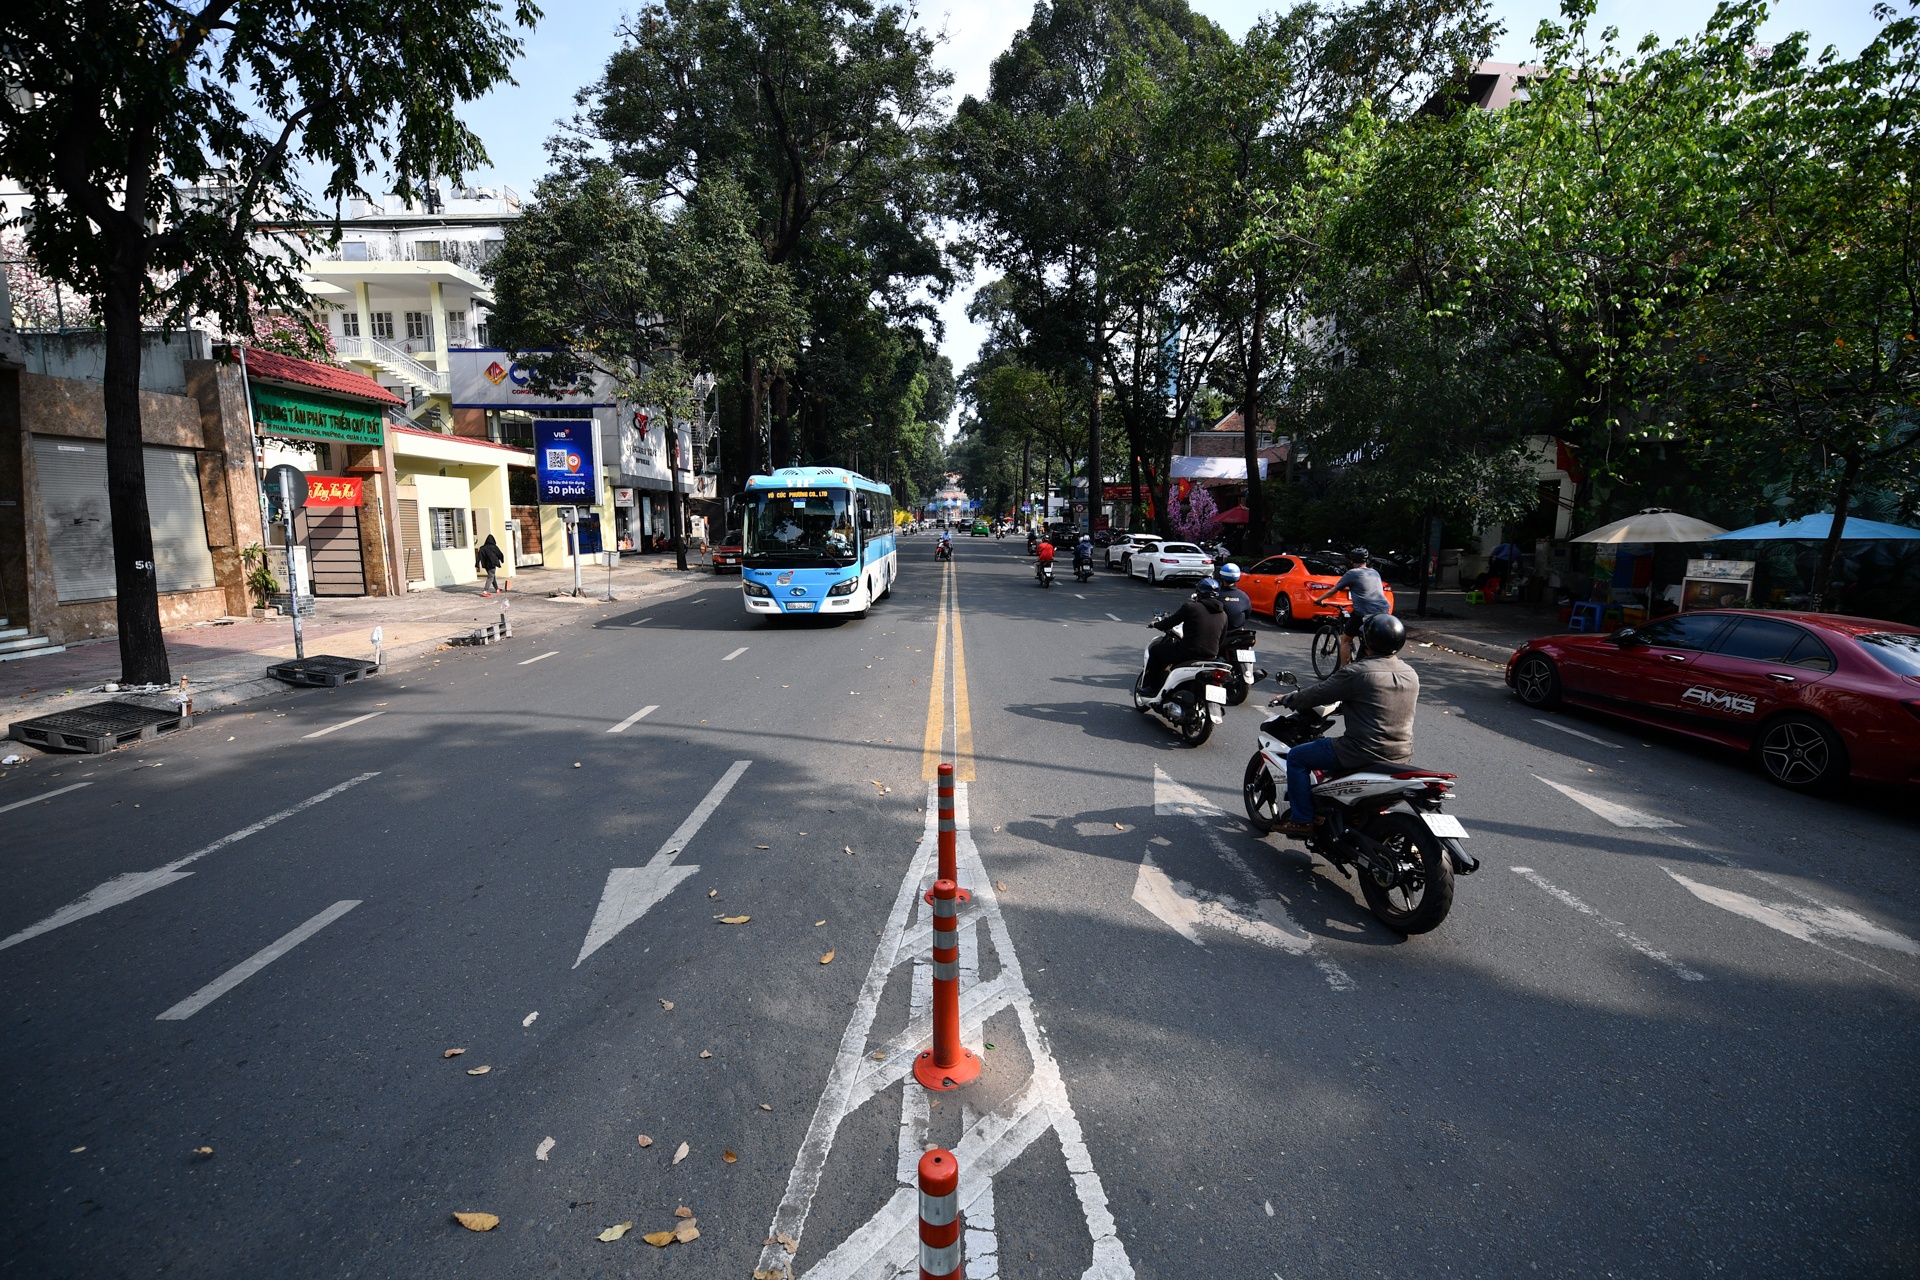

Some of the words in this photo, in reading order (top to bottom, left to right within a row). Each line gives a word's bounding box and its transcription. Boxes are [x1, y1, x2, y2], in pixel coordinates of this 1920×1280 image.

[786, 479, 815, 487] VIP
[548, 486, 560, 494] 30
[562, 485, 585, 496] phút
[1681, 687, 1756, 714] AMG
